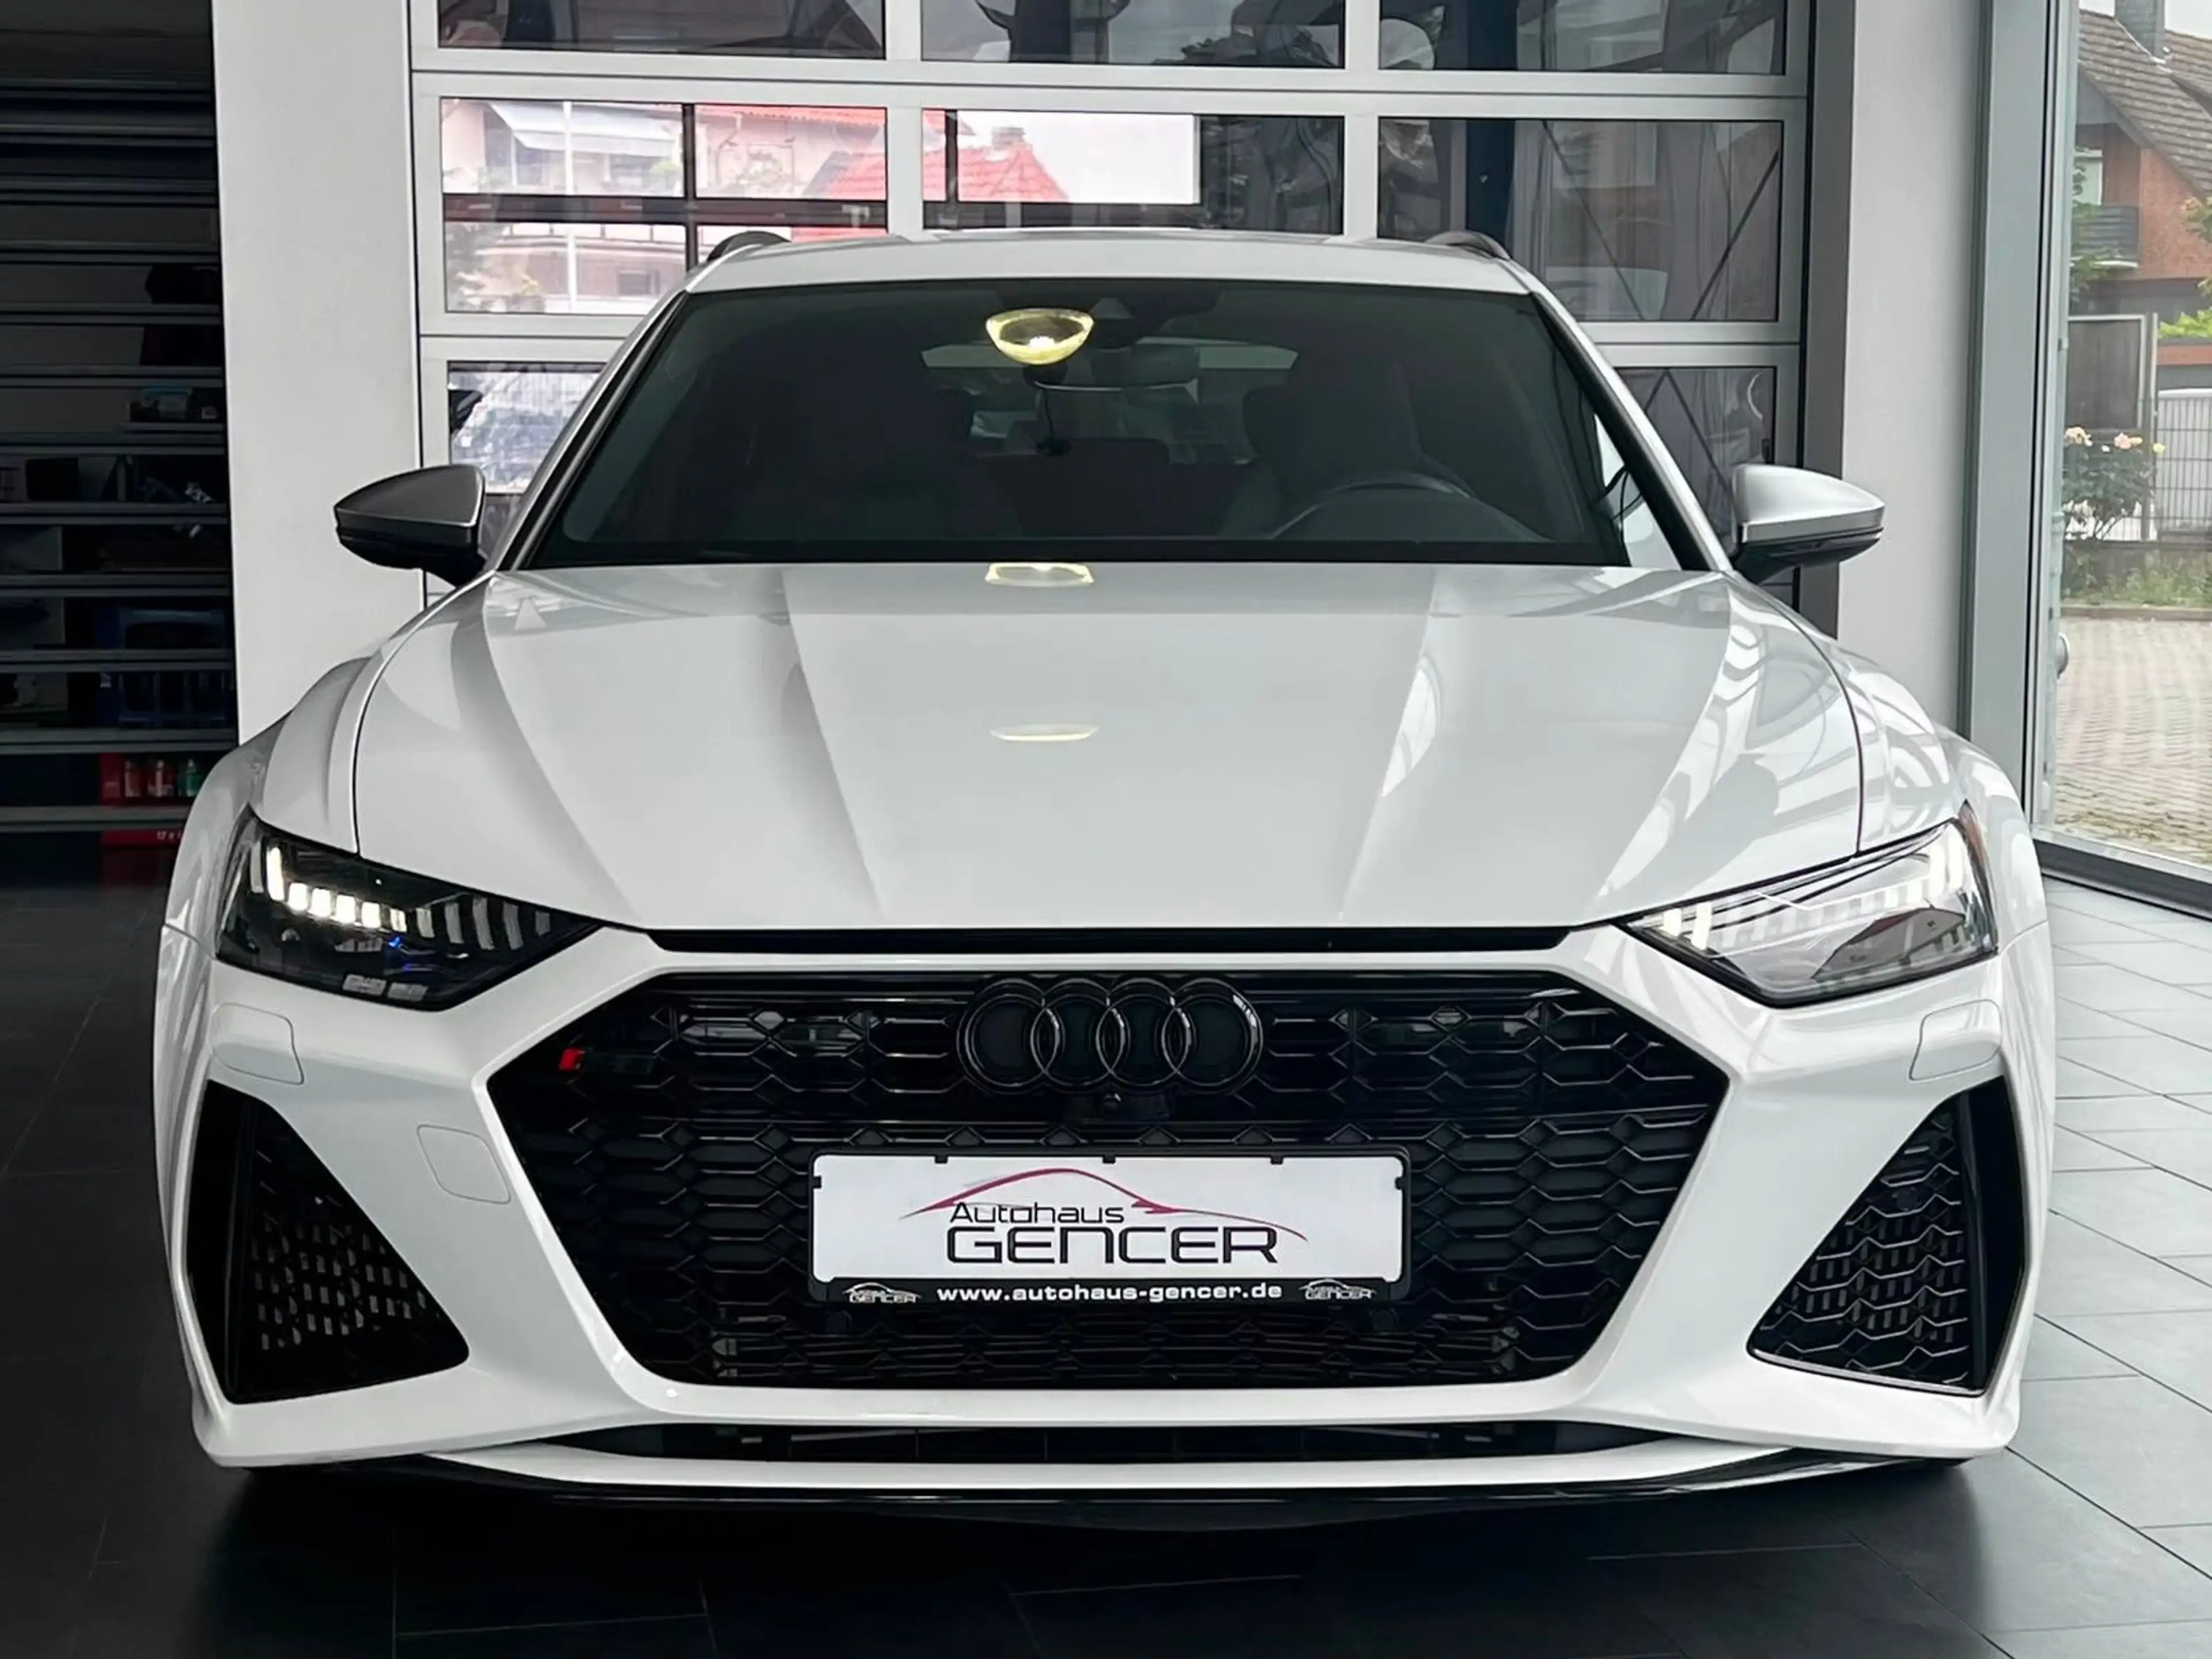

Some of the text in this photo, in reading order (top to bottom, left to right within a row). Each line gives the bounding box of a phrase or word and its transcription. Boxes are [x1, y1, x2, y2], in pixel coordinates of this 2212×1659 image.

[950, 1201, 1125, 1224] Autohaus
[946, 1226, 1279, 1264] GENCER
[937, 1283, 1283, 1302] www.autohaus-gencer.de
